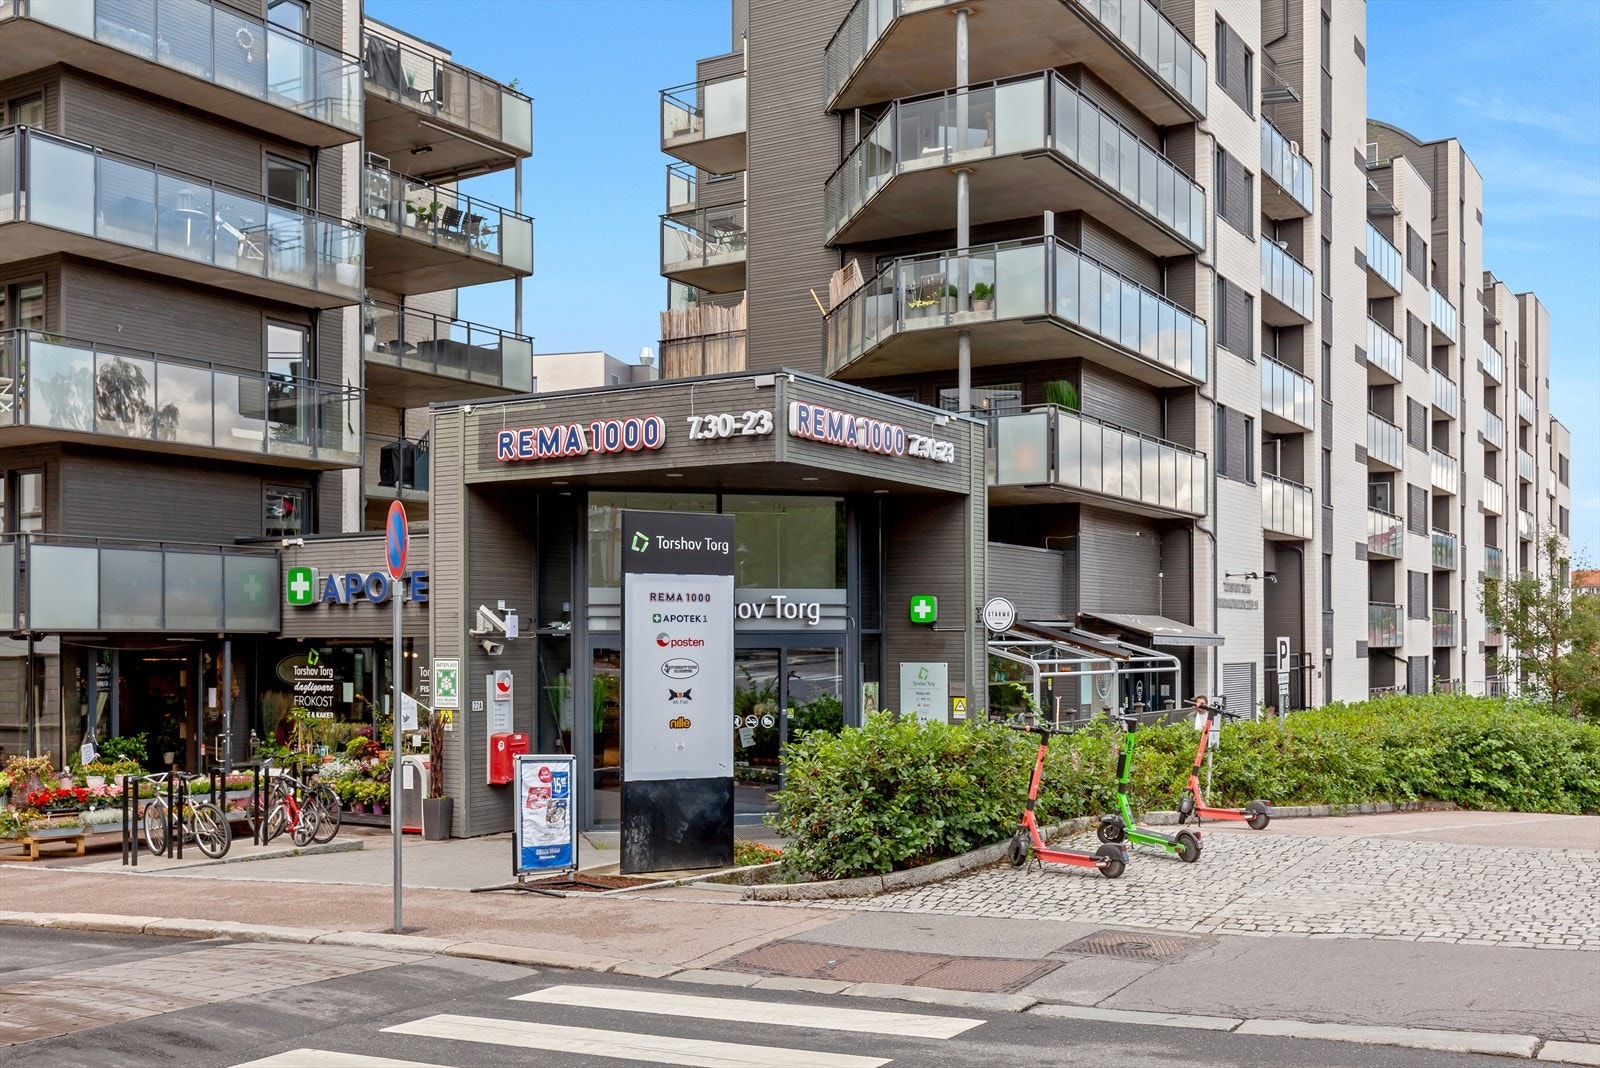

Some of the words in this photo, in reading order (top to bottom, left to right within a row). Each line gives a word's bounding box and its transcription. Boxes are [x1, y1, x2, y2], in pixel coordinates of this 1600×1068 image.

[687, 410, 773, 440] 7.30-23
[791, 402, 859, 446] REMA
[860, 417, 905, 457] 1000
[496, 423, 587, 462] REMA
[590, 415, 666, 454] 1000
[656, 535, 702, 551] Torshov
[704, 537, 729, 555] Torg
[322, 571, 428, 604] APOE
[649, 592, 683, 602] REMA
[686, 593, 711, 602] 1000
[663, 614, 701, 622] APOTEK
[703, 614, 708, 622] 1
[771, 595, 820, 625] Torg
[671, 638, 704, 648] posten
[1280, 640, 1287, 669] P
[293, 665, 318, 676] Torshov
[319, 665, 334, 678] Torg
[293, 681, 334, 694] dagligvare
[293, 695, 334, 707] FROKOST
[669, 716, 691, 729] nille
